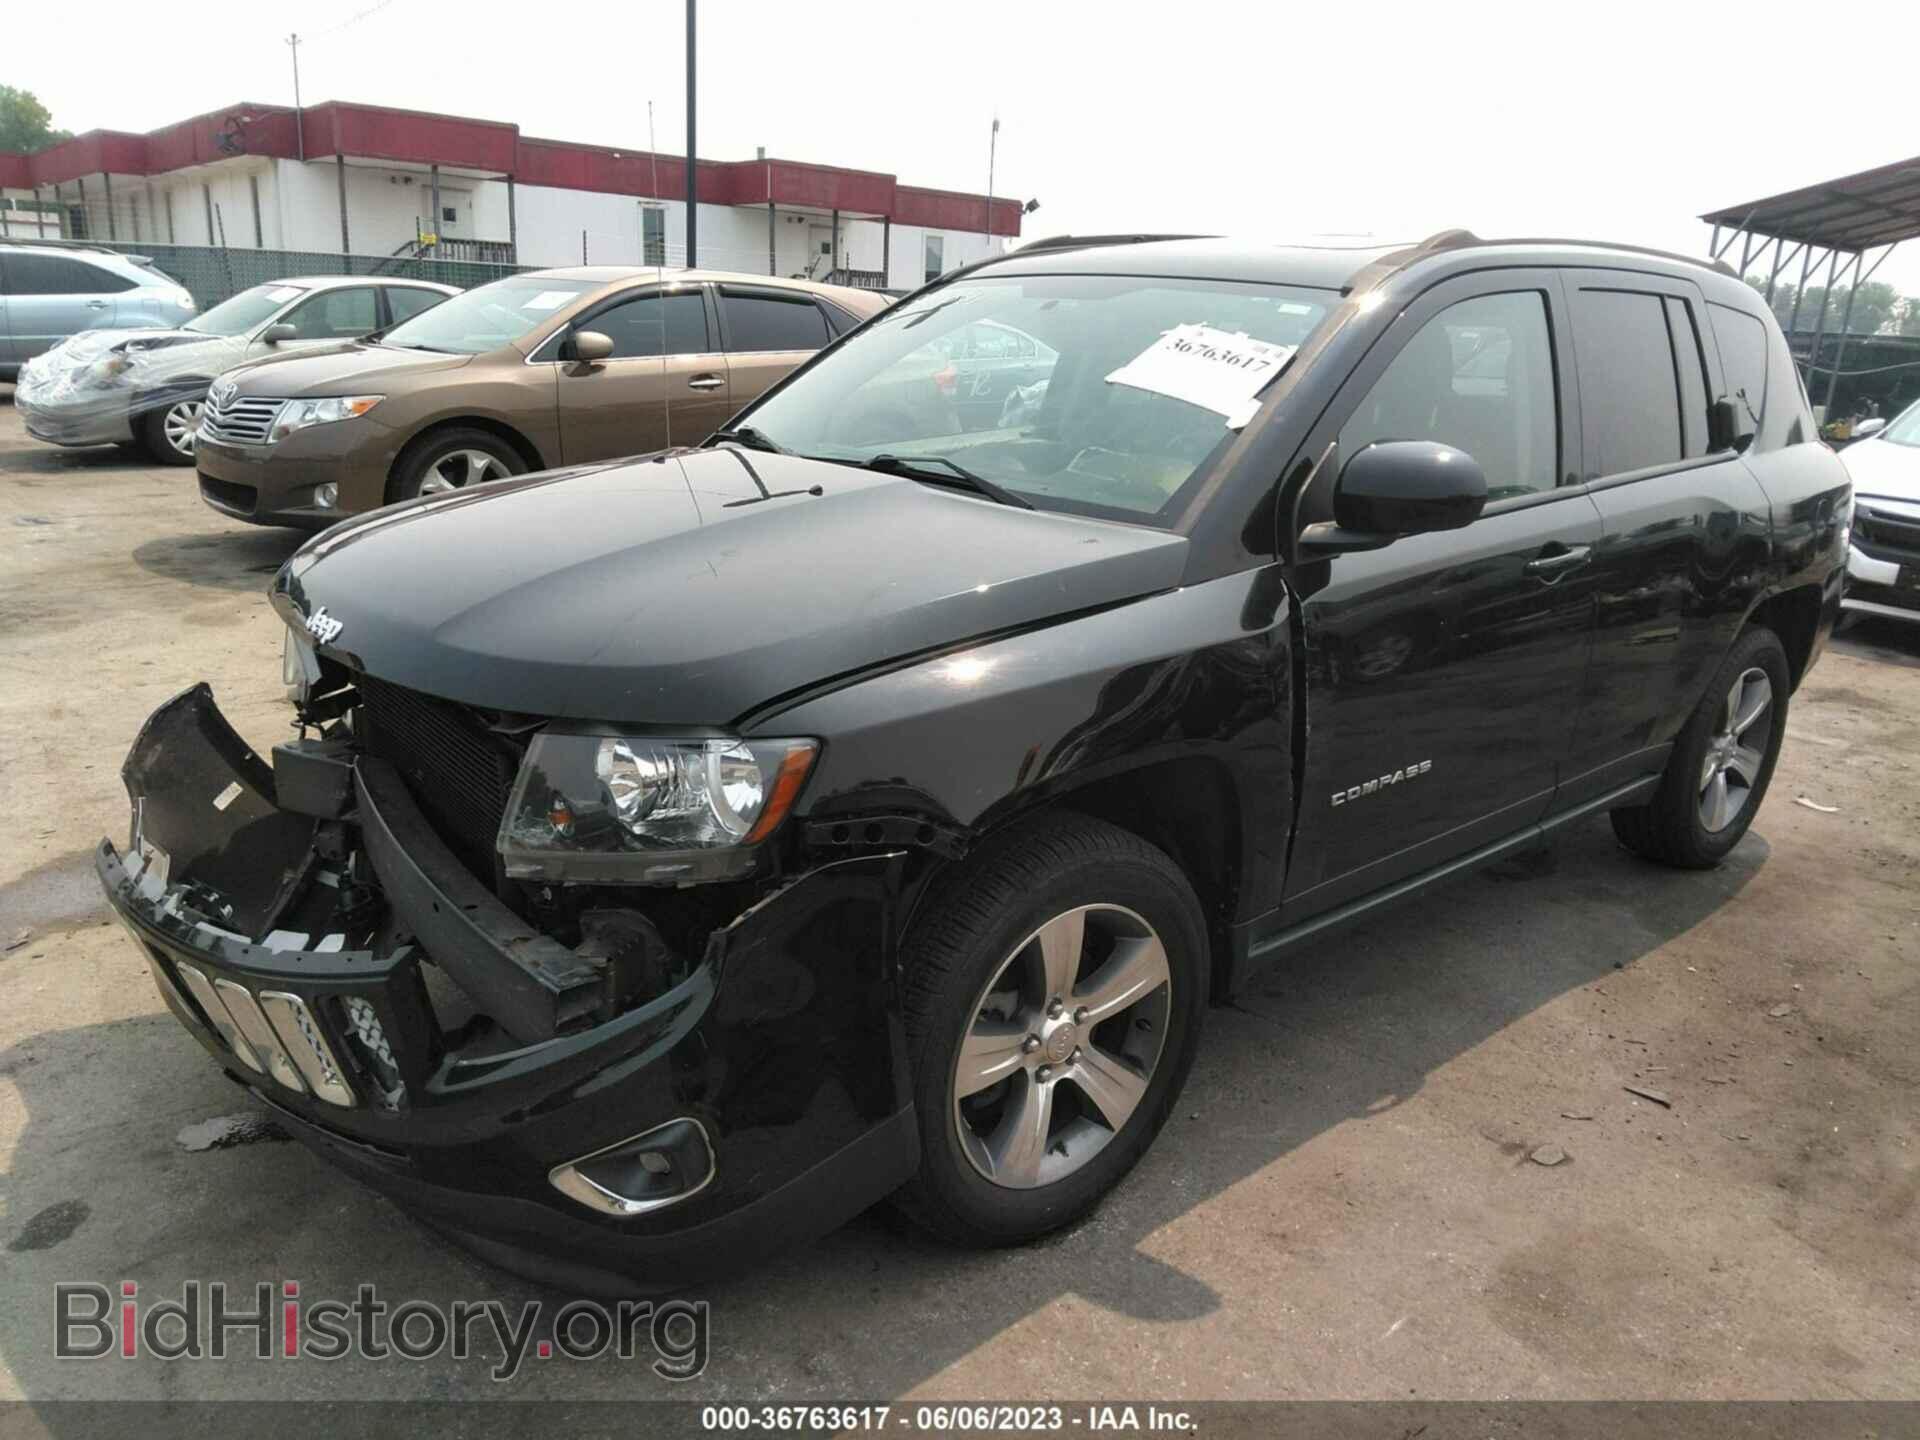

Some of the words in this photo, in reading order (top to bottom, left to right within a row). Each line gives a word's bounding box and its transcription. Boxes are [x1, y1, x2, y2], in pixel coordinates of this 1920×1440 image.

[1166, 338, 1271, 372] 36763617
[305, 606, 343, 645] Jeep
[1331, 759, 1432, 807] COMPASS
